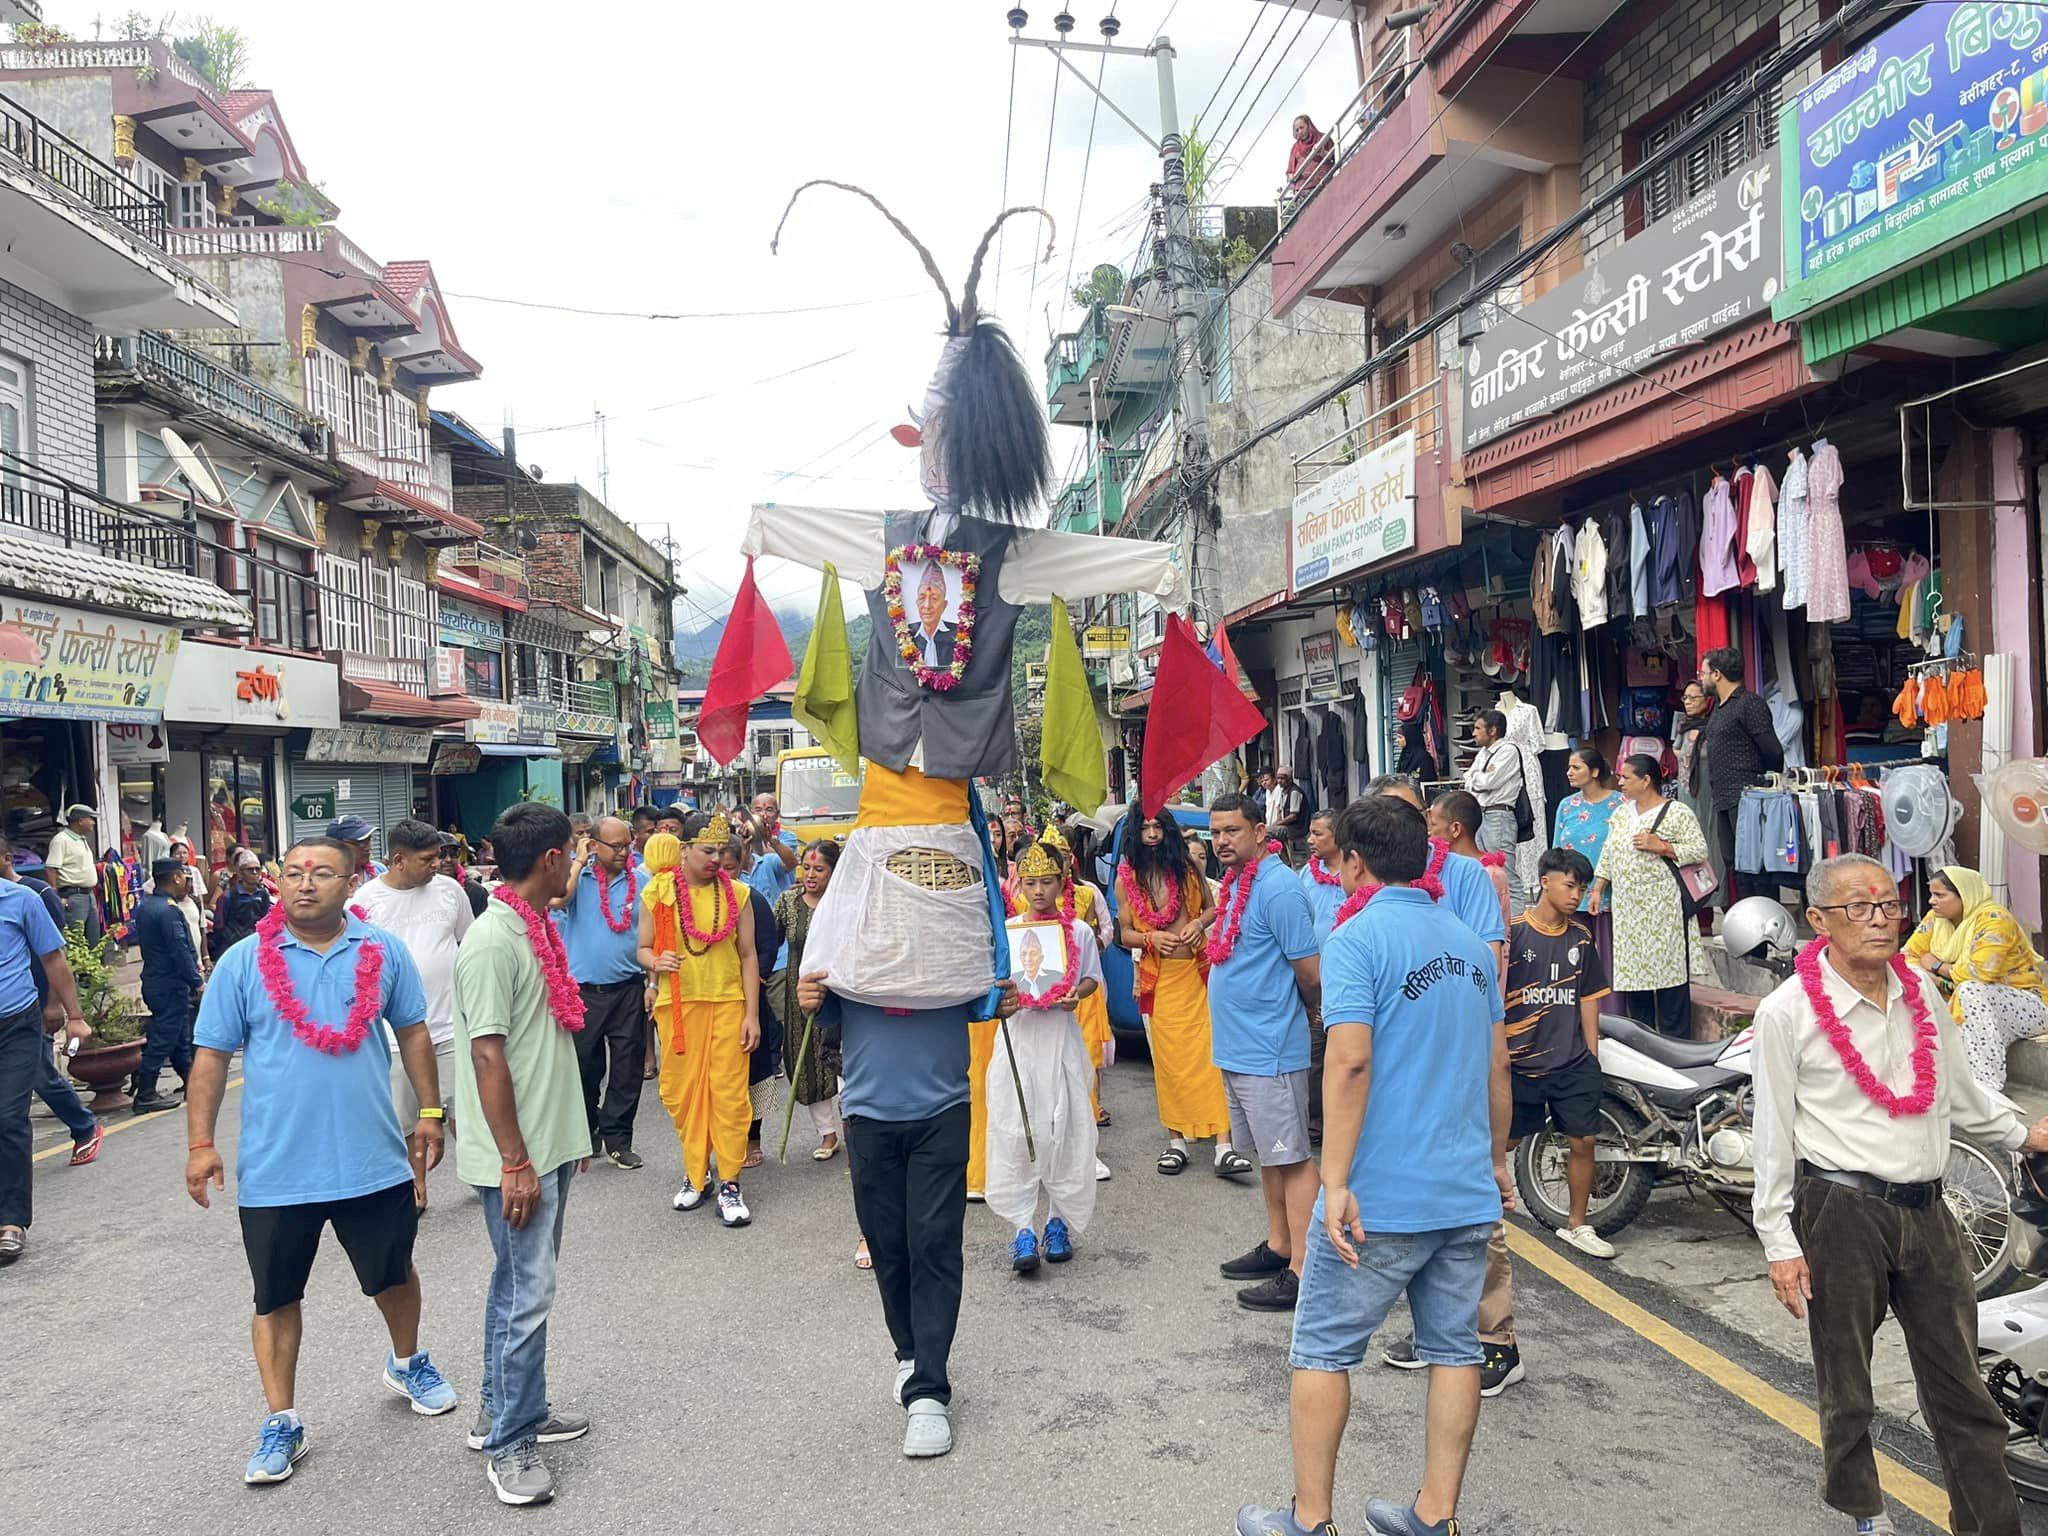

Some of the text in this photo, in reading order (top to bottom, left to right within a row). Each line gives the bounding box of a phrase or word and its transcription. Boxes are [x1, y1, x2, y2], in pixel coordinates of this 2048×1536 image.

[1945, 0, 2048, 74] बिजु
[1470, 202, 1765, 410] नाजिर फेन्सी स्टोर्स
[1332, 527, 1354, 554] FANCY
[1354, 515, 1384, 543] STORES
[58, 618, 117, 672] फेन्सी
[117, 629, 164, 677] स्टोर्स
[236, 664, 278, 704] दर्पण
[307, 804, 323, 818] 06
